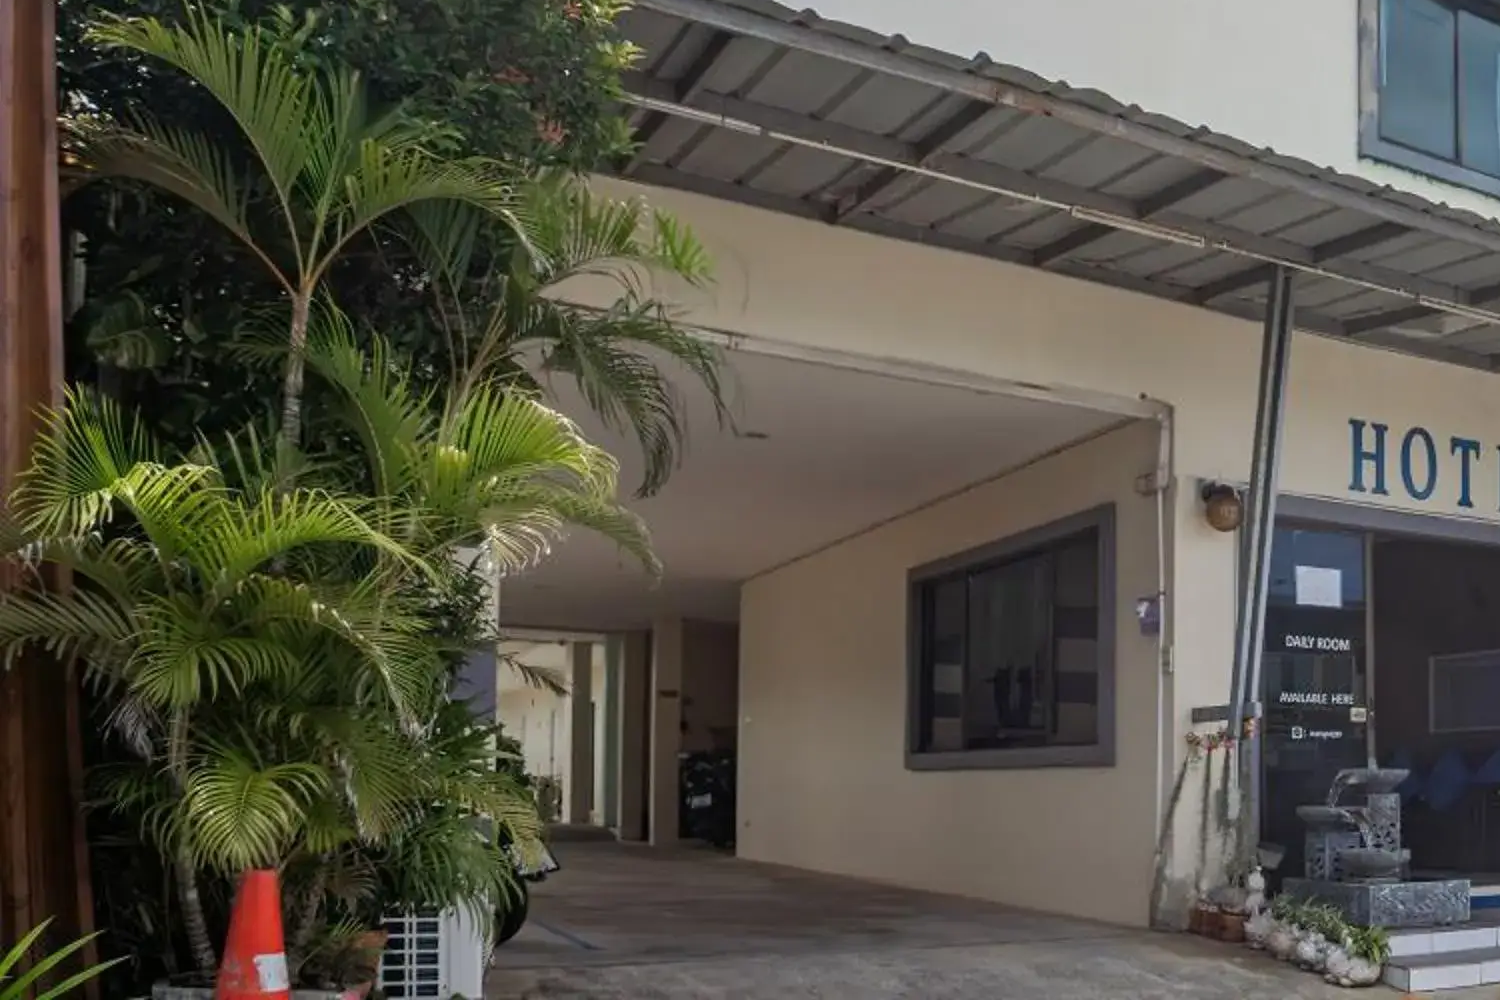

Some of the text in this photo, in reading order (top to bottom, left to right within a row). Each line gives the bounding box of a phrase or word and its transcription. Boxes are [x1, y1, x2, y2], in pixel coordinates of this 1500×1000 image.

[1285, 635, 1351, 652] DAILY ROOM
[1280, 692, 1354, 705] AVAILABLE HERE
